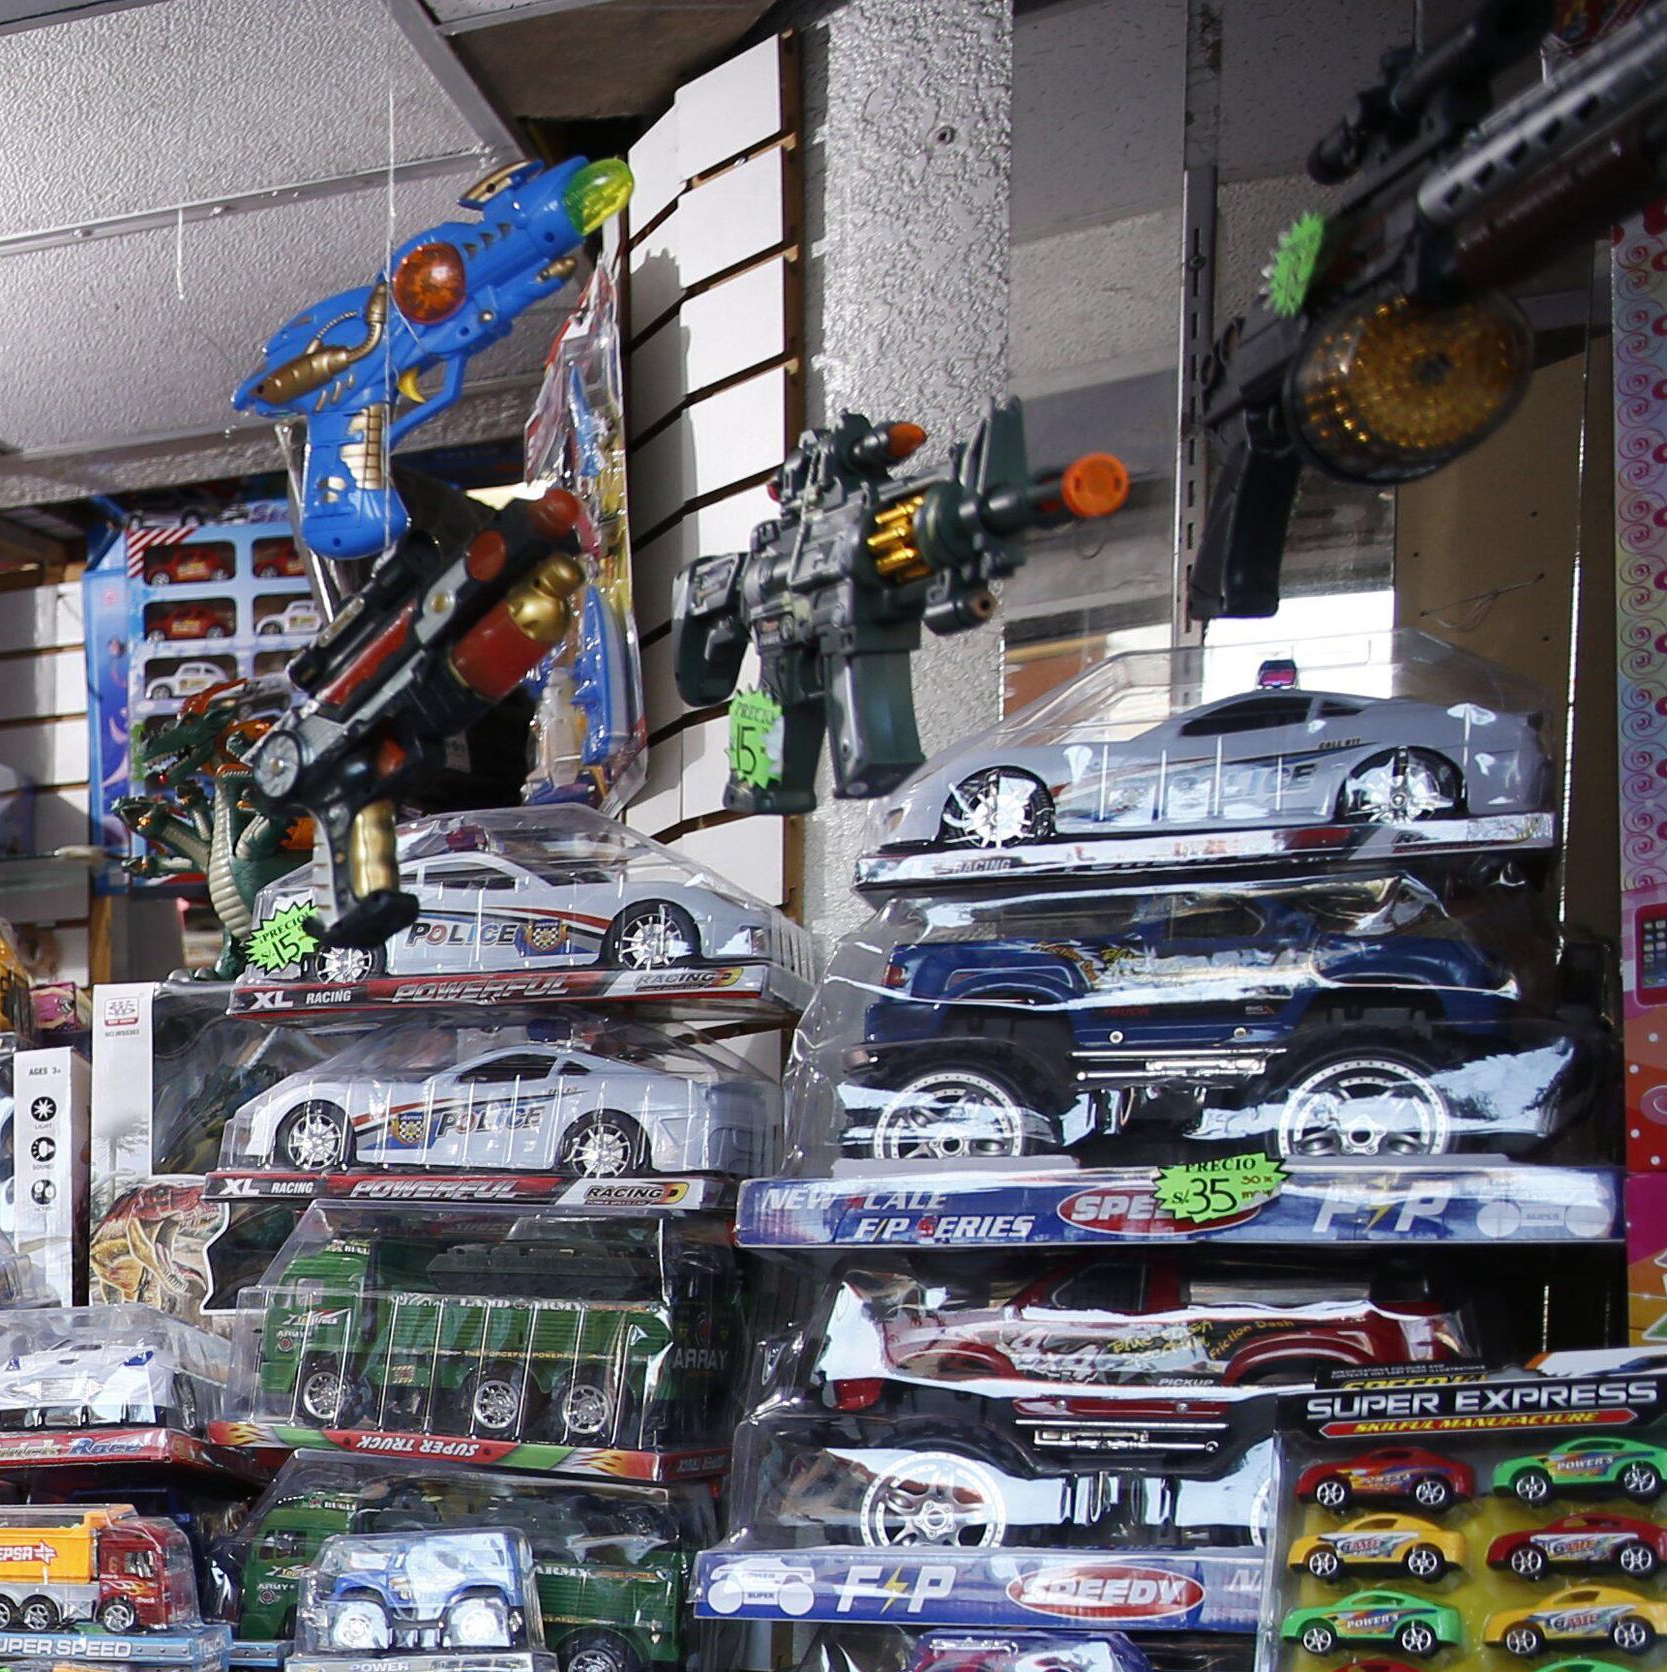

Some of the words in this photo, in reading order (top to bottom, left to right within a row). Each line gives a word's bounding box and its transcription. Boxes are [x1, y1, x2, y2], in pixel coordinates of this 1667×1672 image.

[405, 921, 516, 948] POLICE
[250, 991, 294, 1011] XL
[306, 989, 352, 1004] RACING
[392, 976, 570, 1004] POWERFUL
[634, 968, 717, 986] RACING
[435, 1105, 546, 1136] POLICE
[215, 1175, 260, 1199] XL
[271, 1180, 315, 1194] RACING
[351, 1179, 524, 1200] POWERFUL
[586, 1185, 665, 1200] RACING
[1306, 1392, 1441, 1420] SUPER
[1454, 1380, 1659, 1412] EXPRESS
[1353, 1416, 1430, 1434] SKILFUL
[1433, 1411, 1601, 1432] MANUFACTURE
[356, 1434, 435, 1455] TRUCK
[437, 1439, 479, 1457] SUPER
